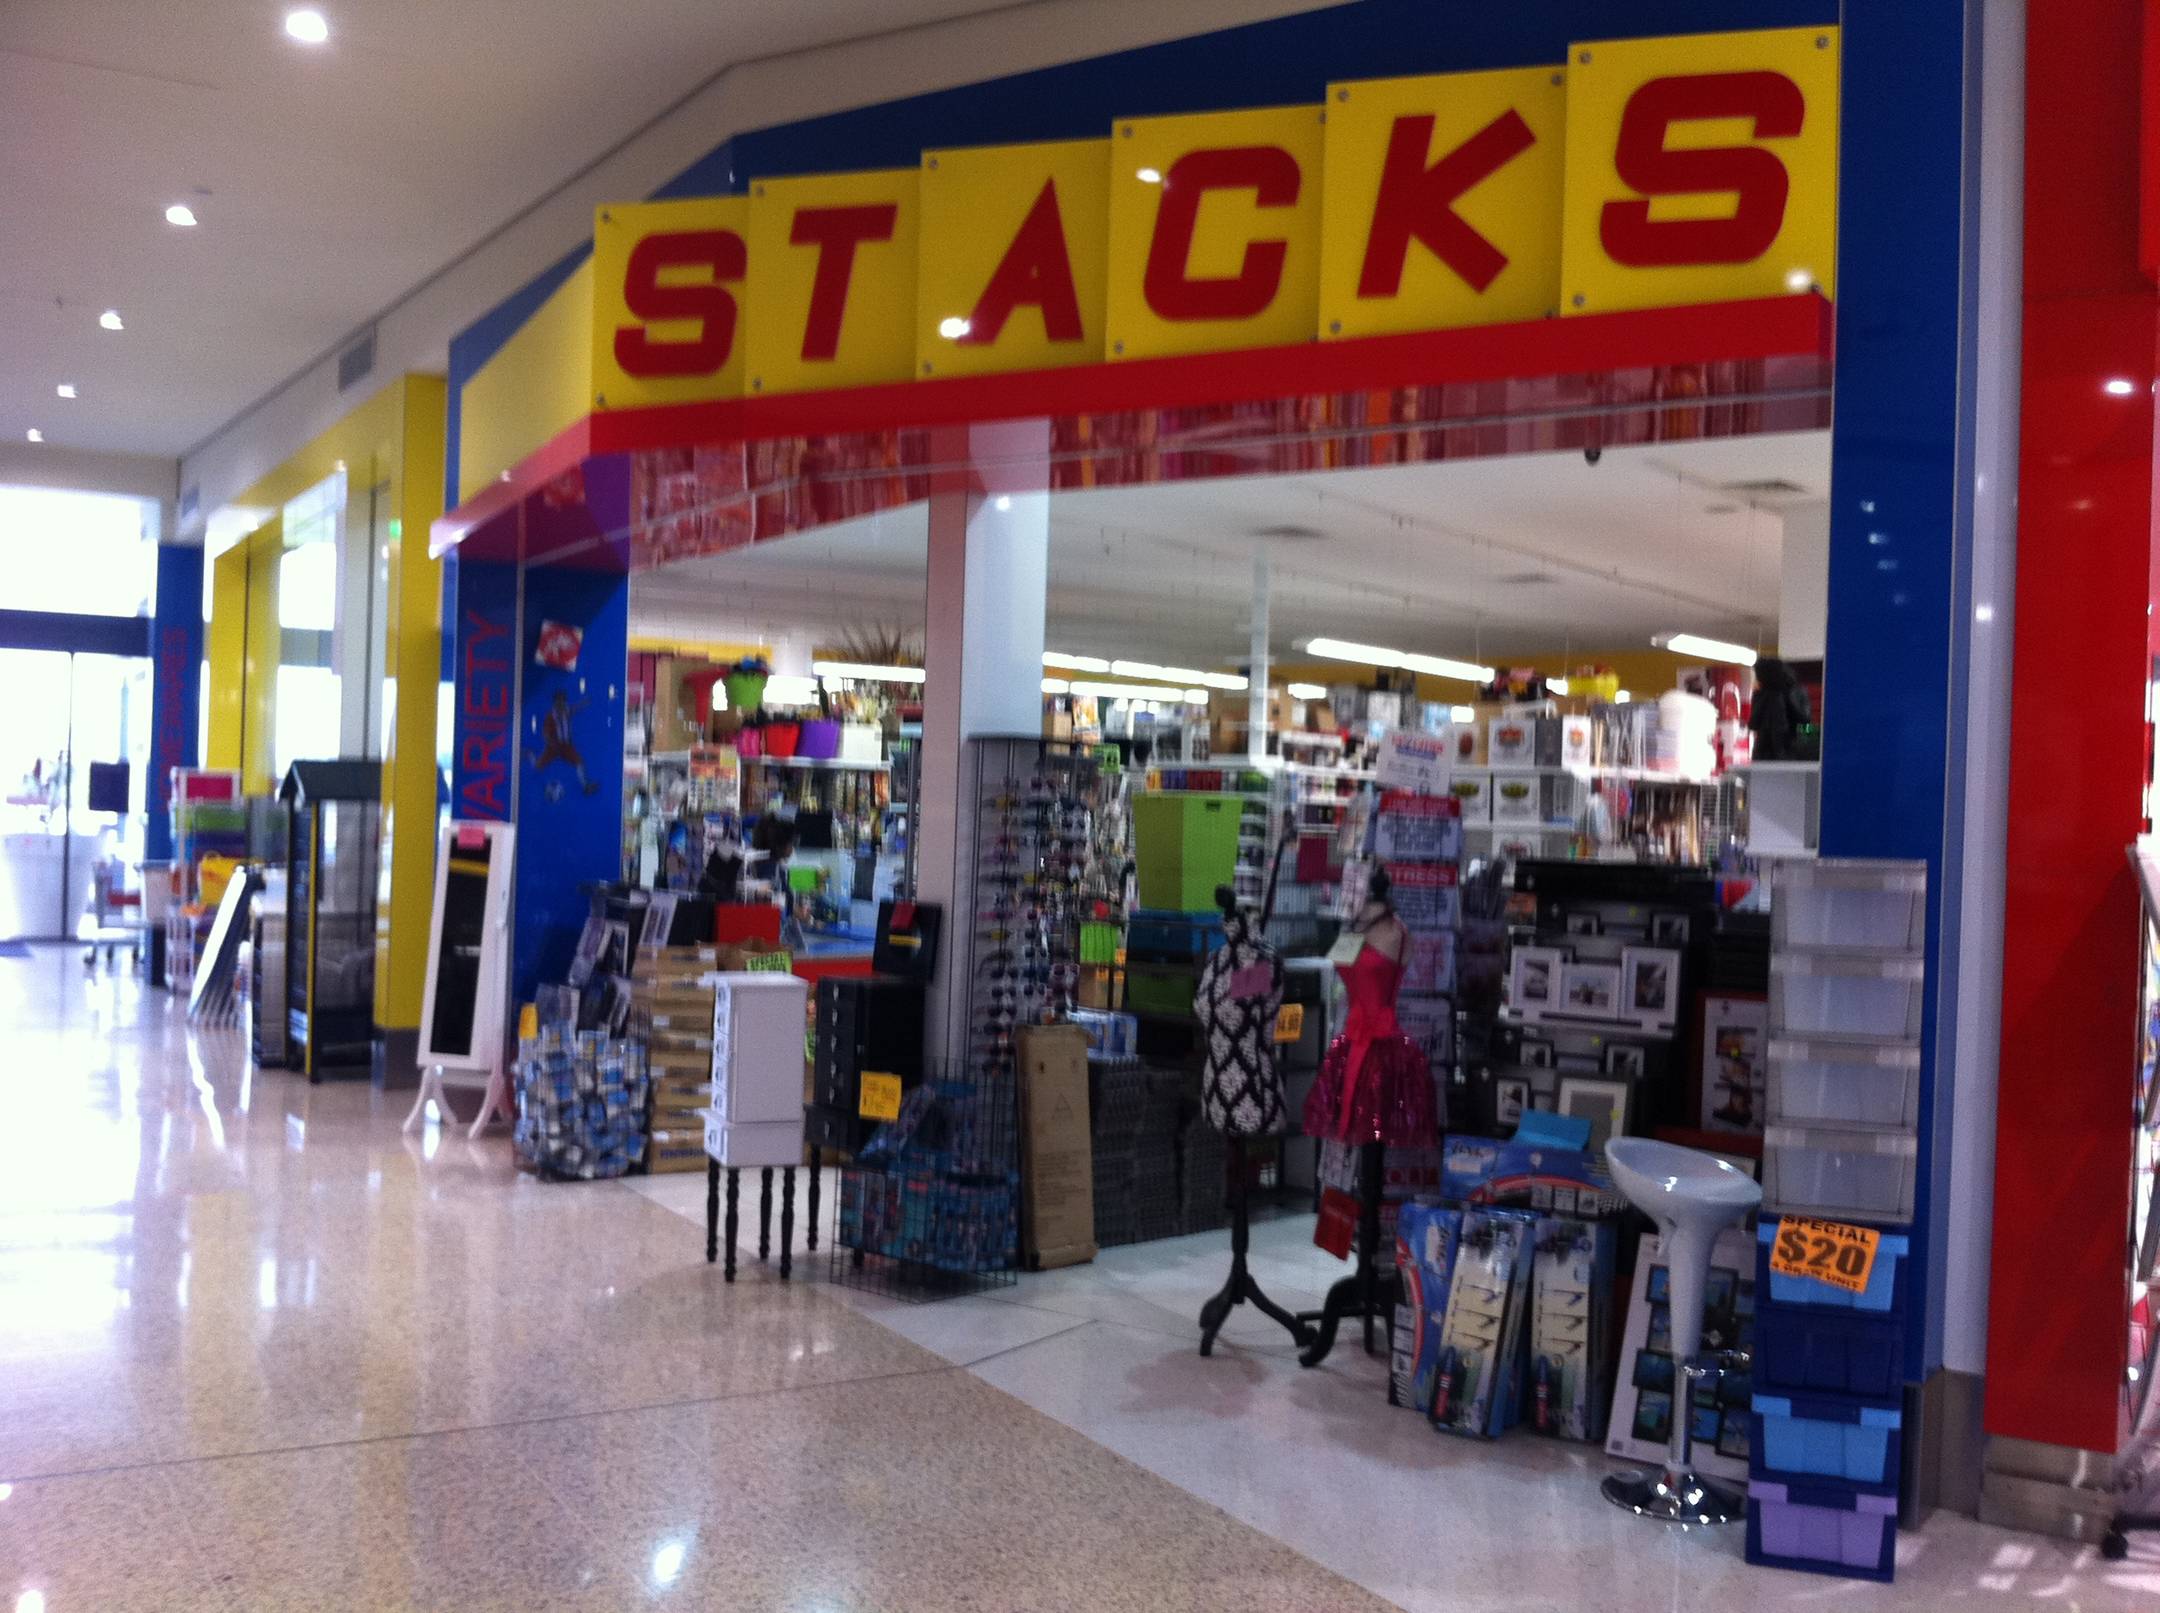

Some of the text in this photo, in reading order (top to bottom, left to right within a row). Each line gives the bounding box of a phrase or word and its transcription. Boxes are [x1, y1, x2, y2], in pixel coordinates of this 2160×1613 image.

[614, 71, 1805, 377] STACKS
[1387, 866, 1450, 886] TRESS
[1783, 1214, 1871, 1245] SPECIAL
[1777, 1228, 1867, 1277] $20
